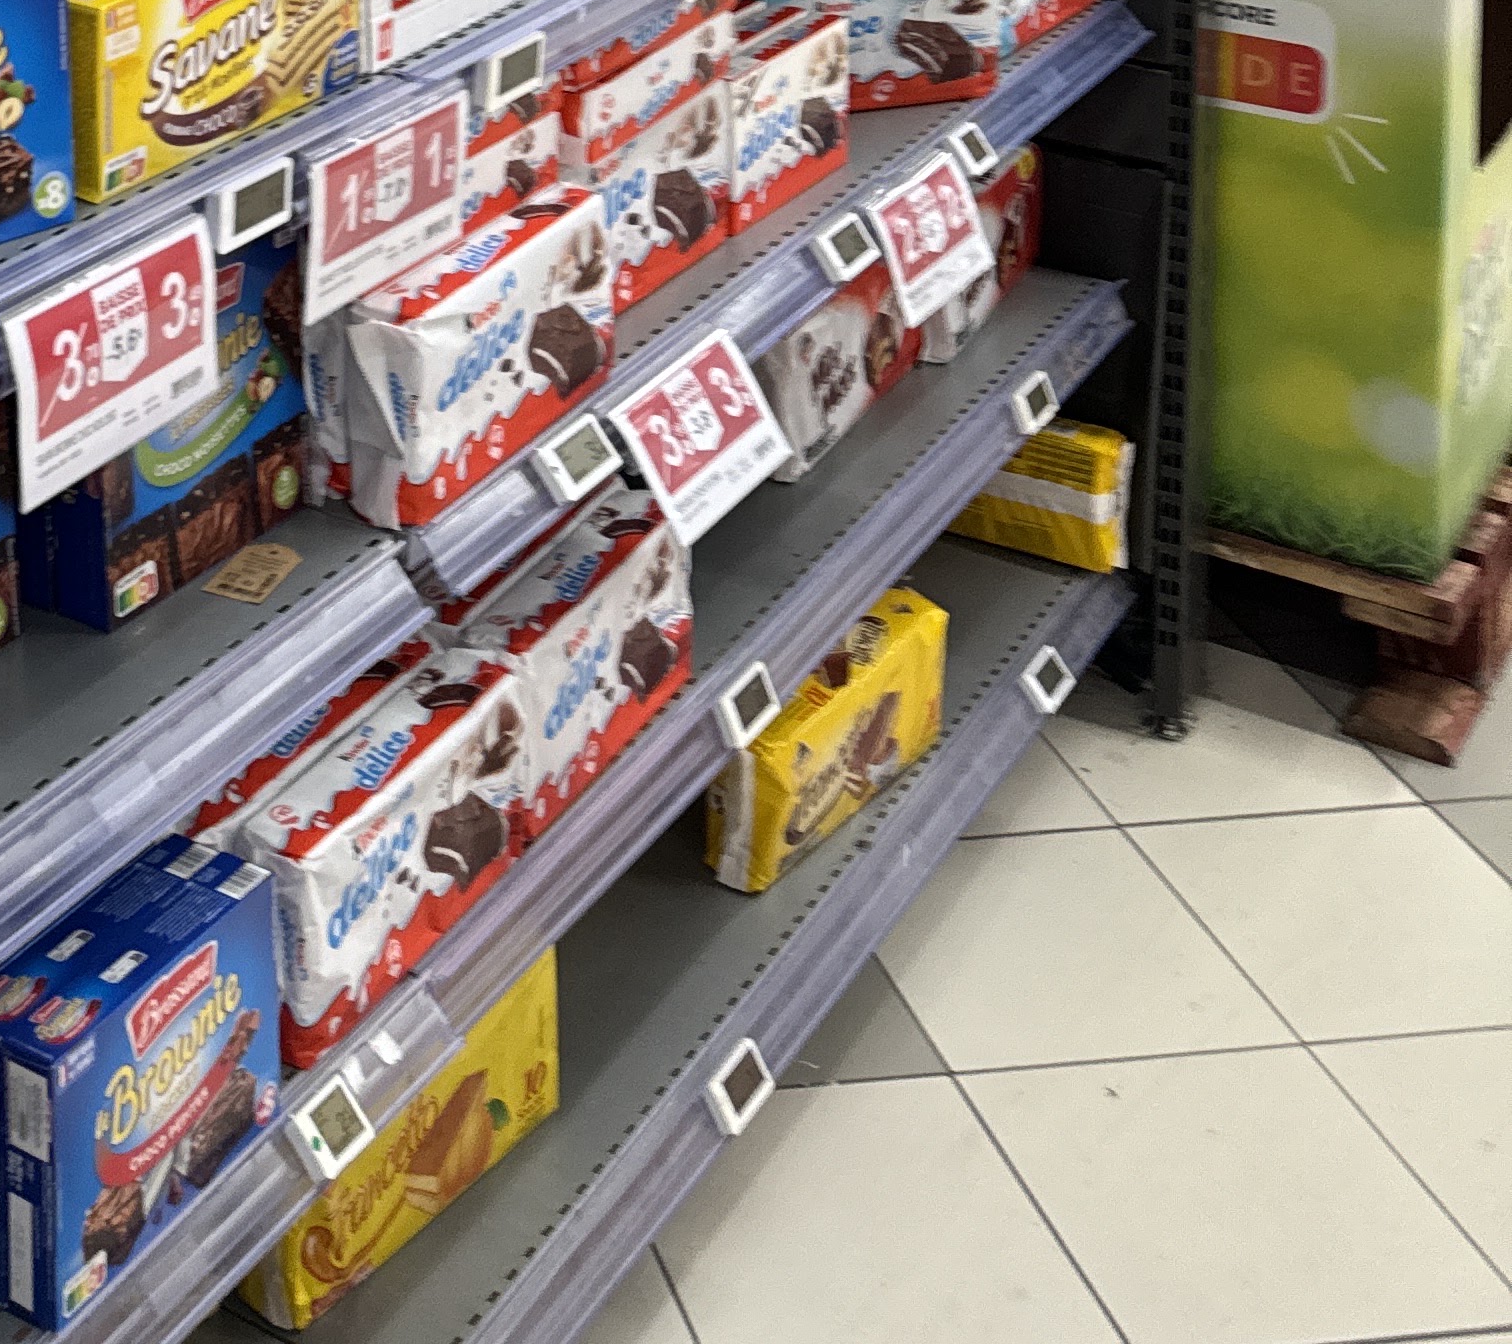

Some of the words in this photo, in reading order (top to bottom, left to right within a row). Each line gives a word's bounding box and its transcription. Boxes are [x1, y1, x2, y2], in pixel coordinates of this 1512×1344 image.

[1241, 53, 1275, 87] D
[1289, 61, 1315, 97] E
[354, 728, 412, 791] délice
[110, 972, 243, 1145] Brownie
